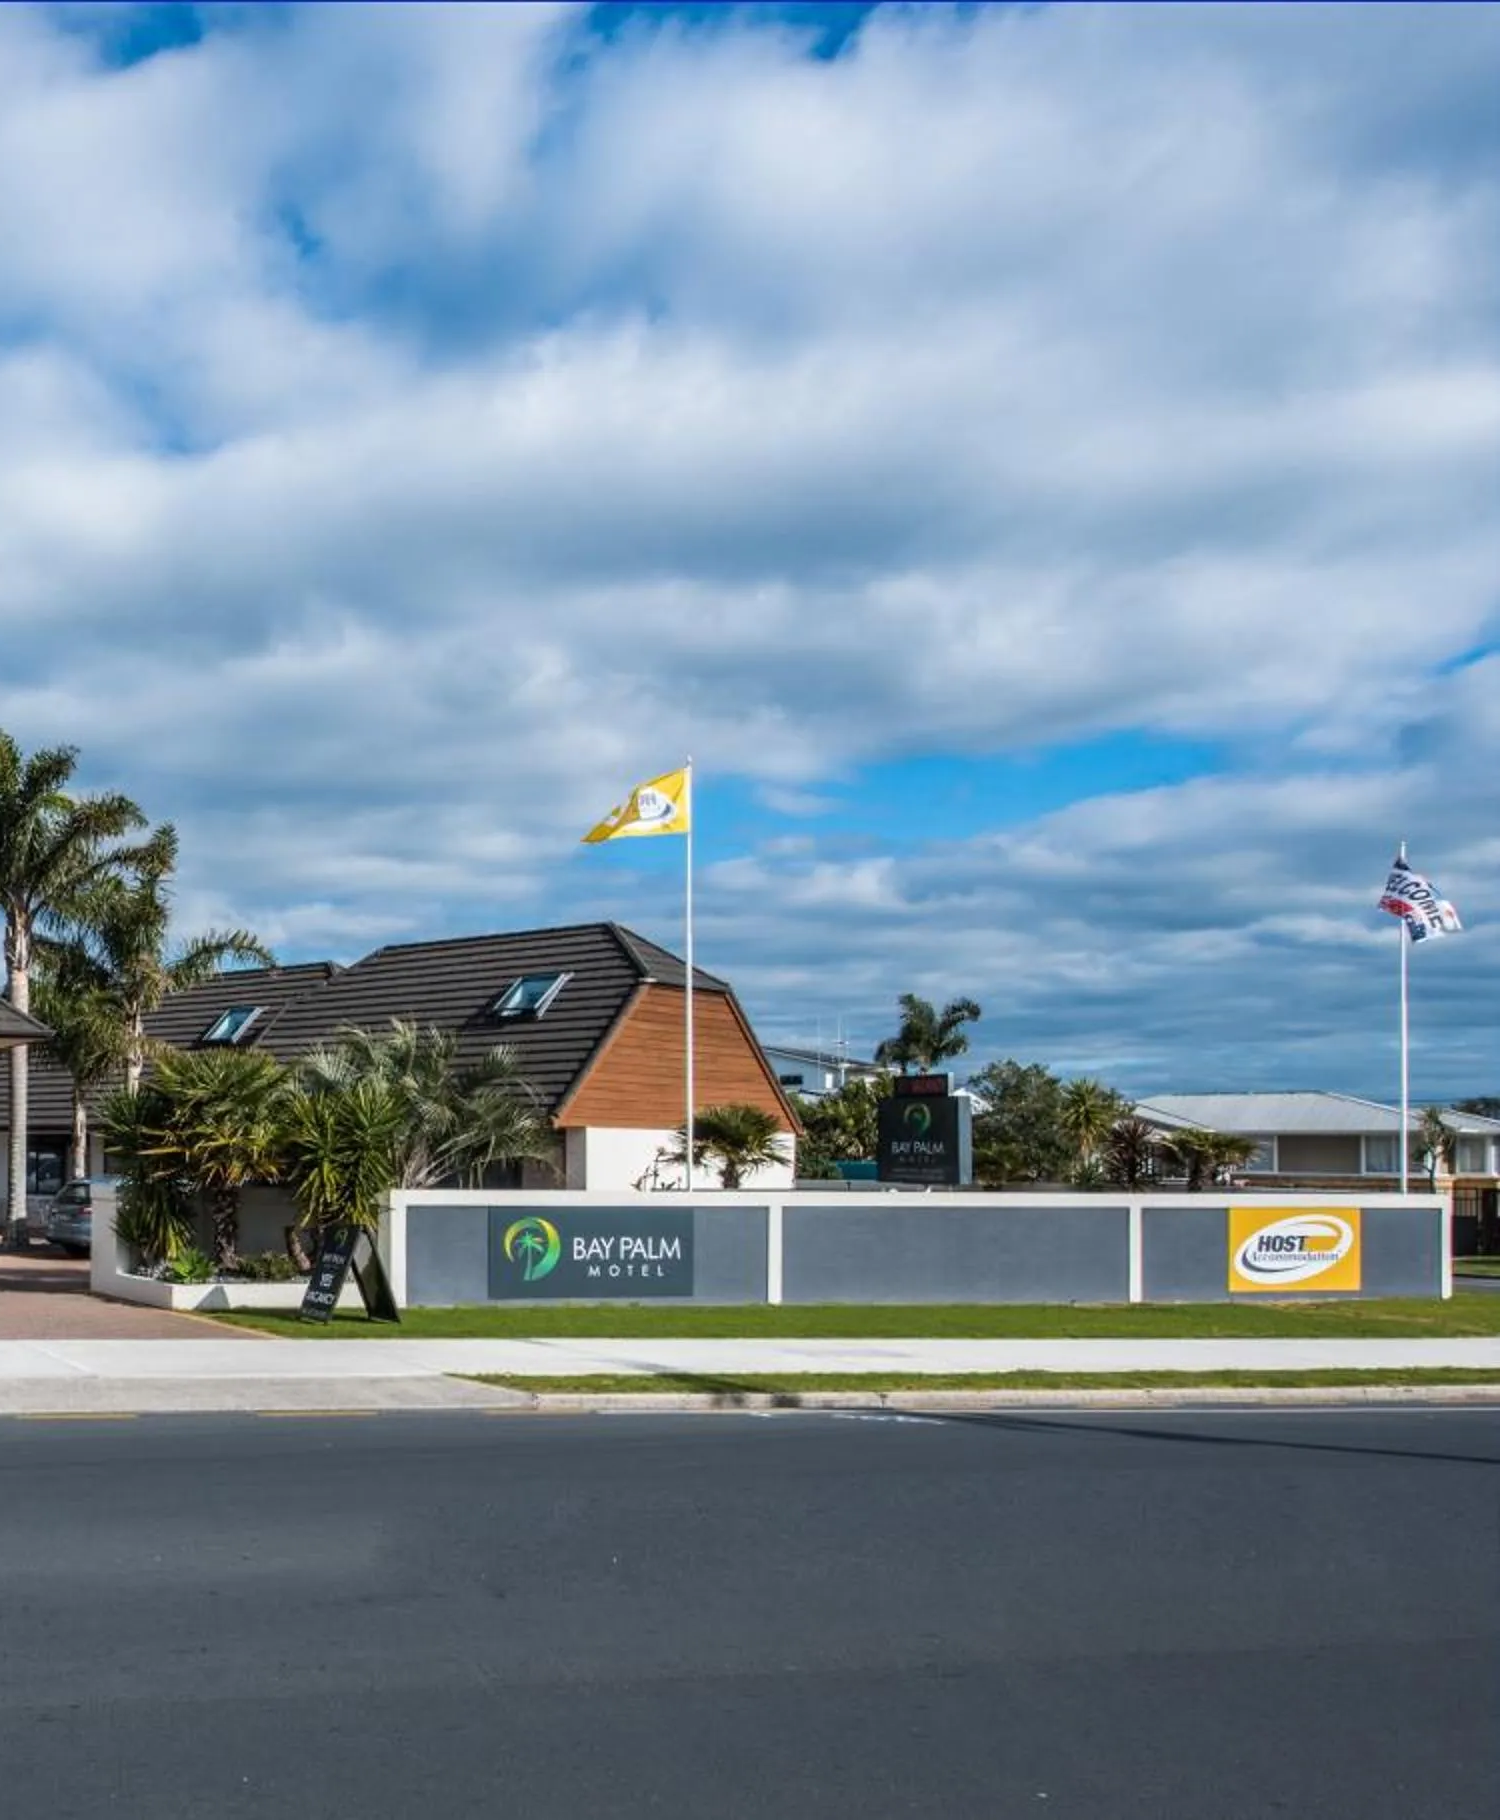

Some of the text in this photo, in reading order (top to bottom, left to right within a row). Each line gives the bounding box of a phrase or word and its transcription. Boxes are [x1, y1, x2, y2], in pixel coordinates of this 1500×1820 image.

[1385, 873, 1444, 929] ELCOME
[891, 1140, 945, 1154] BAY PALM
[573, 1236, 681, 1261] BAY PALM
[1257, 1235, 1308, 1253] HOST
[587, 1264, 664, 1277] MOTEL
